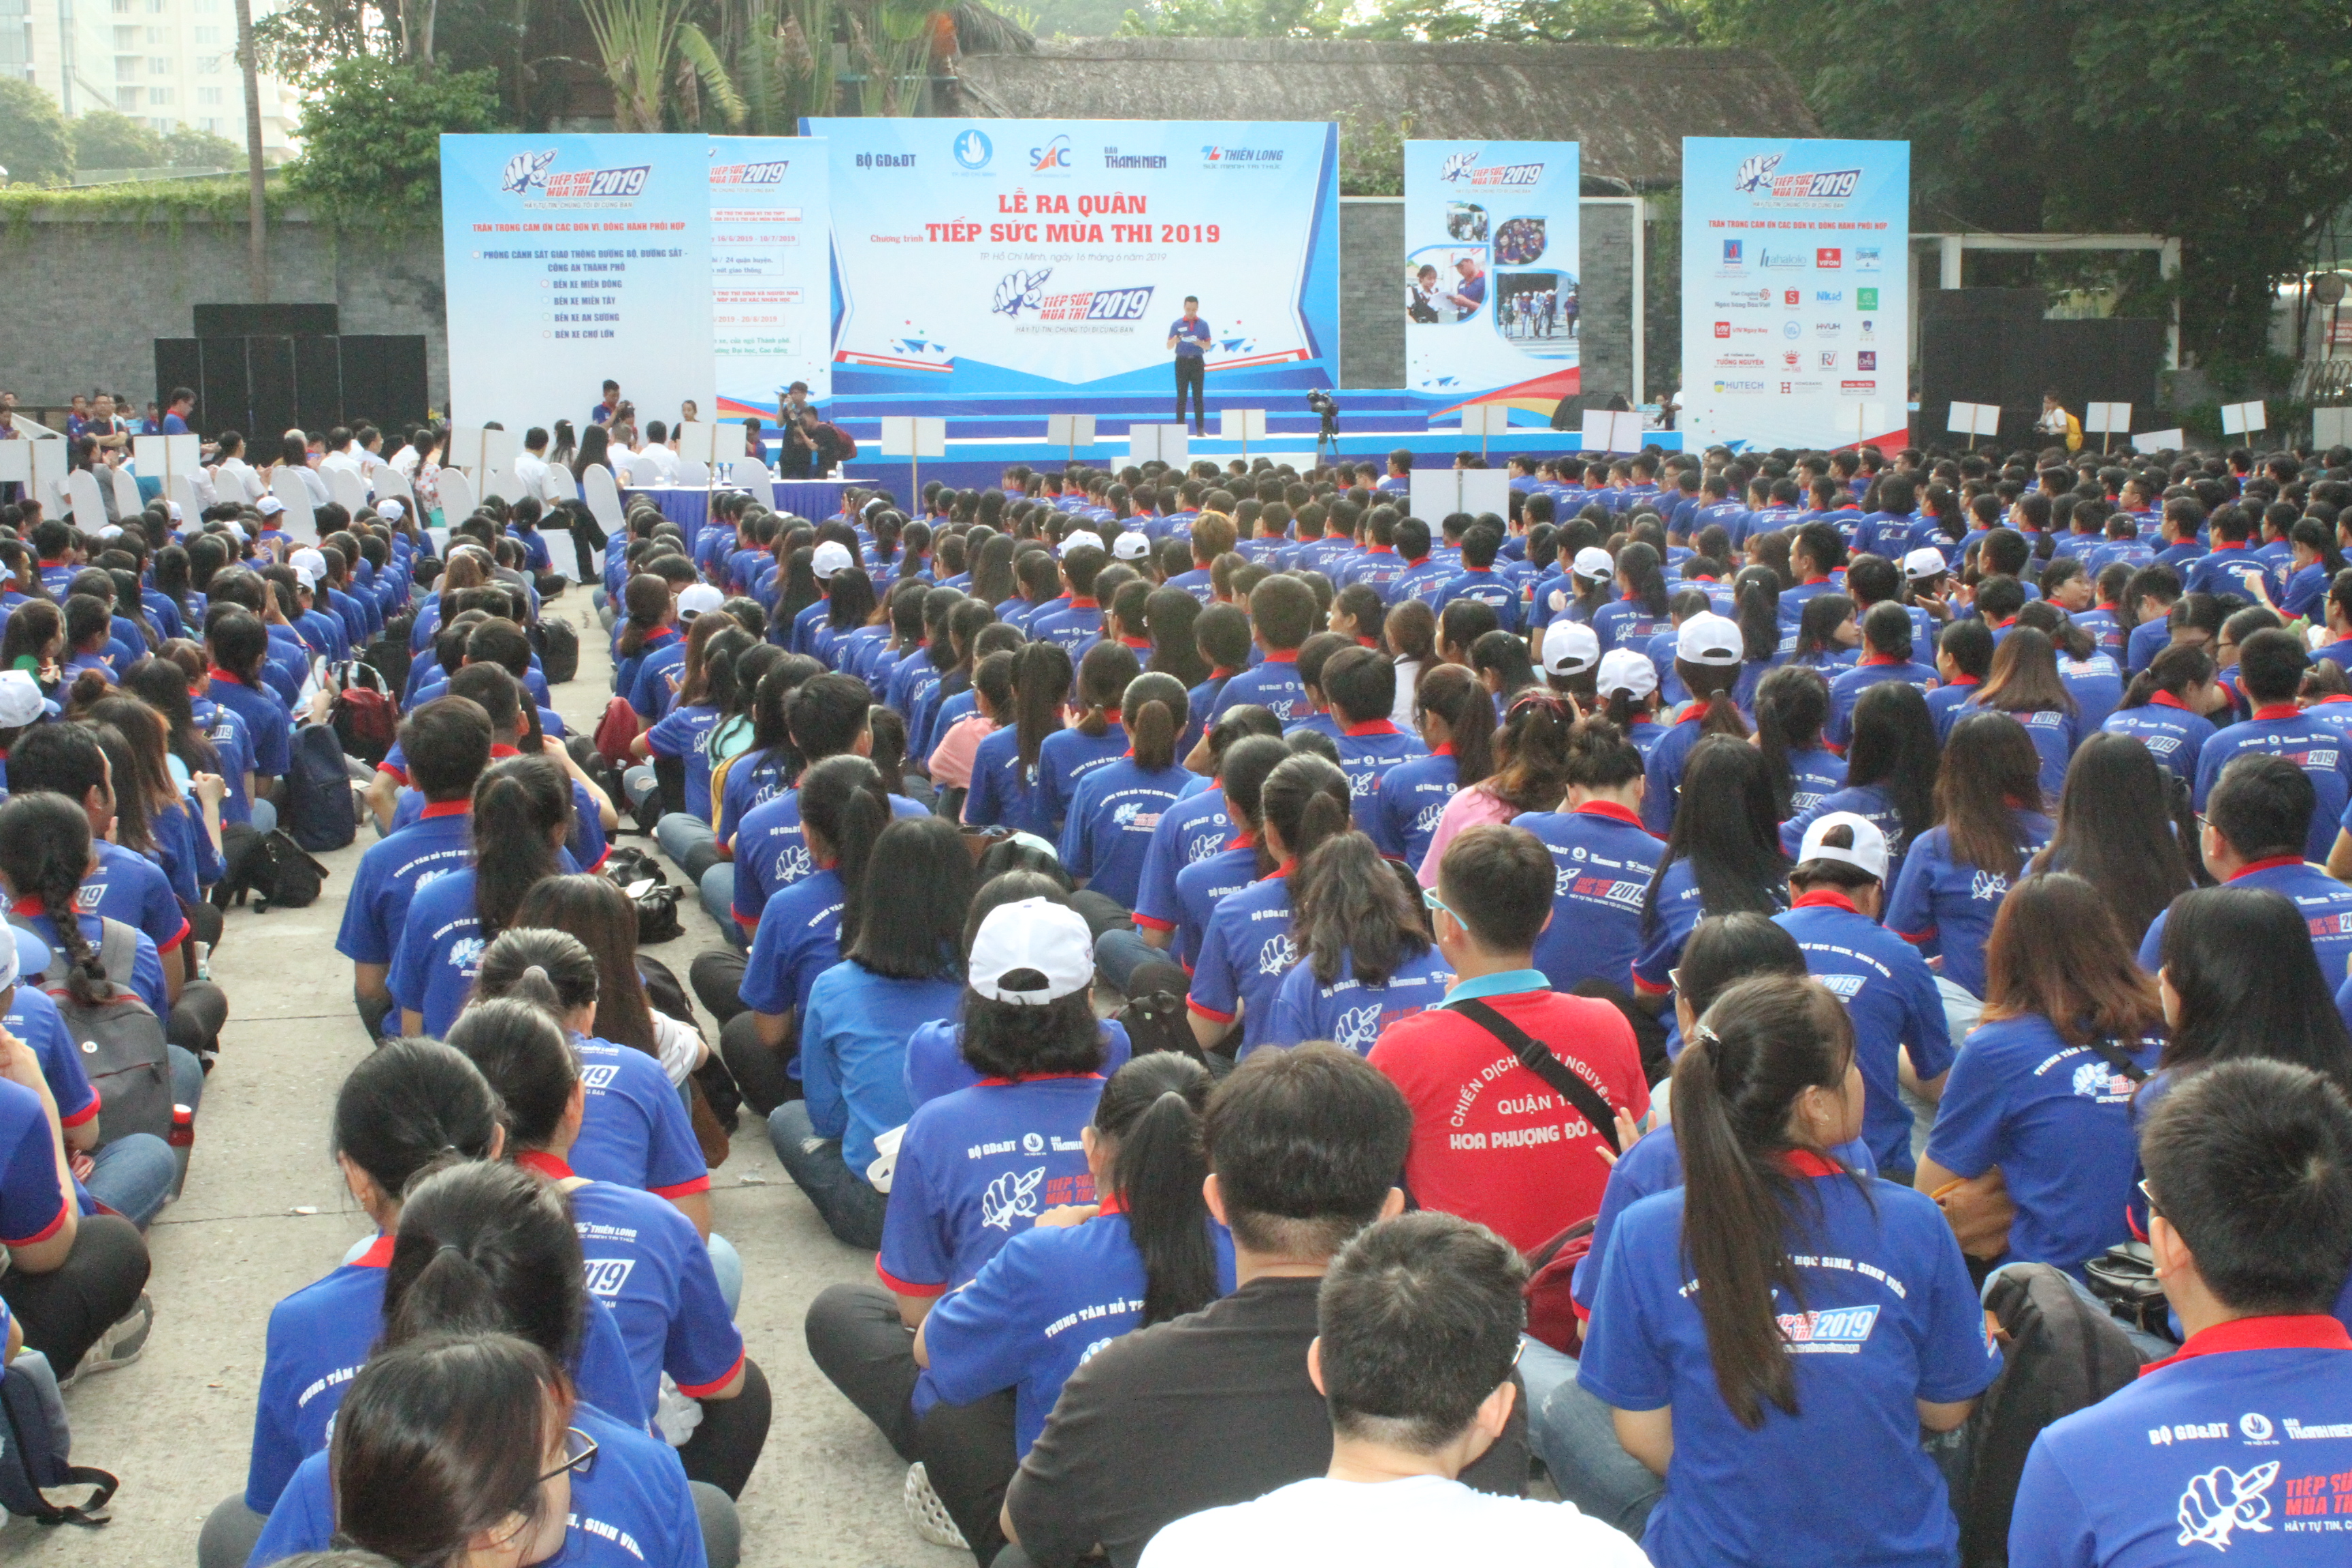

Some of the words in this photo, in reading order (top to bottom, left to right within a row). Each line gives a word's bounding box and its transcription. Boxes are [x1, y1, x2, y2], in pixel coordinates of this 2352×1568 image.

[856, 152, 872, 169] BỘ
[1225, 148, 1254, 161] THIÊN
[1256, 150, 1284, 161] LONG
[549, 174, 572, 186] TIẾP
[574, 169, 595, 184] SỨC
[591, 168, 646, 195] 2019
[742, 163, 786, 182] 2019
[1502, 165, 1542, 184] 2019
[572, 185, 589, 197] THI
[1793, 187, 1808, 197] THI
[1810, 172, 1857, 196] 2019
[998, 187, 1028, 214] LỄ
[1036, 195, 1070, 214] RA
[1077, 191, 1147, 218] QUÂN
[870, 234, 900, 244] Chương
[904, 234, 924, 242] trình
[925, 216, 982, 242] TIẾP
[990, 219, 1038, 242] SỨC
[1046, 220, 1104, 243] MÙA
[1111, 224, 1153, 243] THI
[1162, 224, 1220, 243] 2019
[992, 252, 1005, 261] Hồ
[1007, 252, 1023, 261] Chí
[1024, 252, 1047, 262] Minh,
[1050, 253, 1073, 263] ngày
[1075, 253, 1085, 261] 16
[1088, 252, 1114, 263] tháng
[1115, 253, 1122, 261] 6
[1124, 252, 1144, 261] năm
[1146, 253, 1166, 261] 2019
[570, 280, 578, 289] XE
[602, 295, 615, 305] TÂY
[1043, 295, 1068, 308] TIẾP
[1070, 291, 1094, 306] SỨC
[1088, 290, 1151, 318] 2019
[1040, 308, 1065, 320] MÙA
[1068, 308, 1088, 320] THI
[1726, 381, 1764, 389] HUTECH
[2310, 751, 2336, 764] 2019
[1450, 1077, 1484, 1127] CHIẾN
[1481, 1055, 1520, 1082] DỊCH
[1497, 1094, 1552, 1115] QUẬN
[1450, 1132, 1486, 1149] HOA
[1491, 1125, 1560, 1149] PHƯỢNG
[1564, 1116, 1588, 1139] ĐỎ
[968, 1145, 982, 1159] BỘ
[615, 1227, 637, 1238] LONG
[1795, 1256, 1818, 1268] HỌC
[1857, 1262, 1886, 1281] SINH
[1885, 1275, 1907, 1299] VIÊN
[1045, 1313, 1078, 1338] TRUNG
[1079, 1305, 1107, 1321] TÂM
[1109, 1297, 1126, 1314] HỖ
[1815, 1311, 1873, 1338] 2019
[298, 1378, 326, 1408] TRUNG
[327, 1368, 354, 1386] TÂM
[2148, 1425, 2173, 1446] BỘ
[2285, 1475, 2327, 1497] TIẾP
[2285, 1497, 2328, 1516] MÙA
[584, 1518, 619, 1541] SINH
[2285, 1521, 2305, 1532] HÃY
[2309, 1521, 2322, 1533] TỰ
[2324, 1521, 2342, 1531] TIN,
